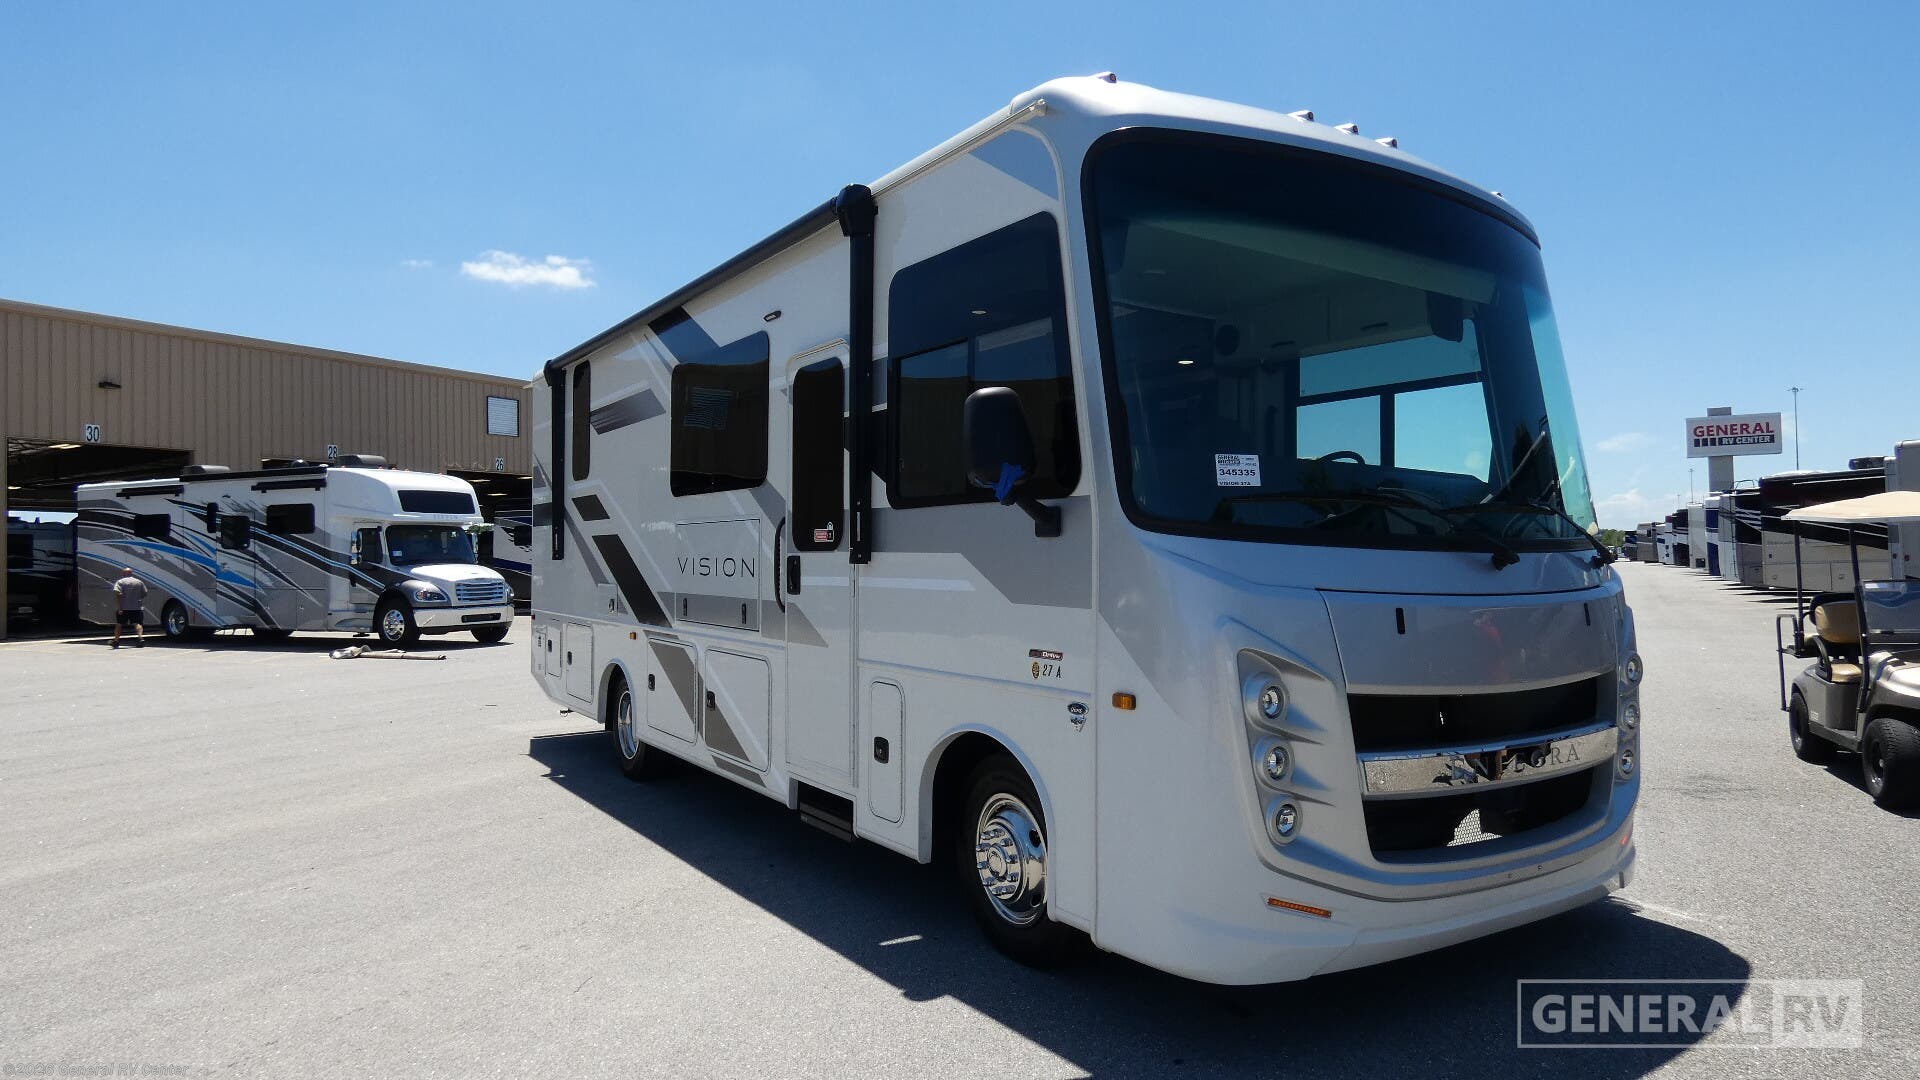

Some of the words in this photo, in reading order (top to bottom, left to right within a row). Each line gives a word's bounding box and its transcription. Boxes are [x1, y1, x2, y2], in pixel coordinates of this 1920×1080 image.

[86, 425, 100, 442] 30
[1693, 422, 1775, 437] GENERAL
[1722, 437, 1736, 445] RV
[1737, 435, 1771, 444] CENTER
[328, 445, 338, 459] 28
[496, 458, 504, 471] 26
[677, 557, 755, 578] VISION
[1042, 664, 1053, 677] 27
[1055, 665, 1062, 679] A
